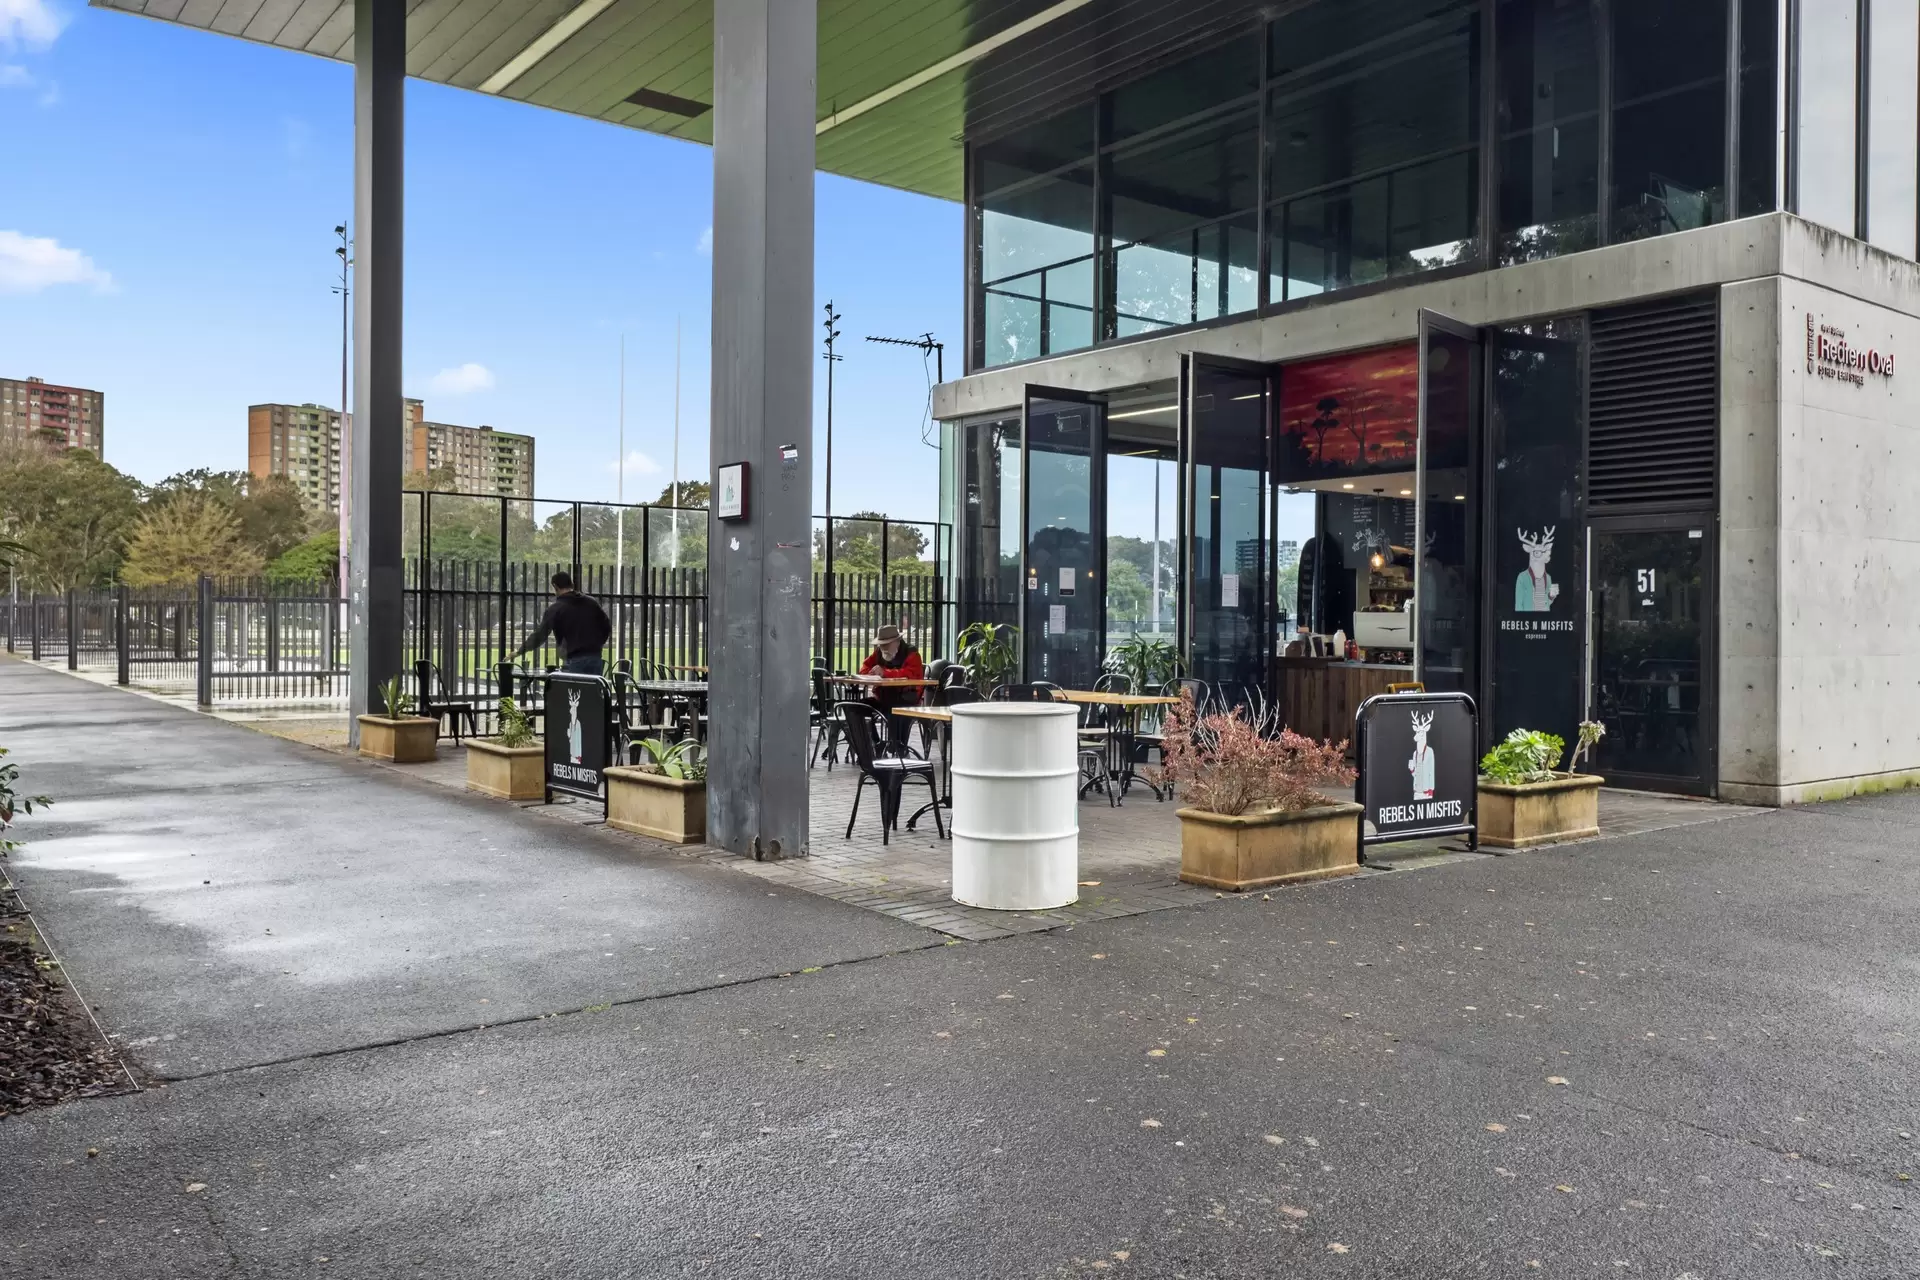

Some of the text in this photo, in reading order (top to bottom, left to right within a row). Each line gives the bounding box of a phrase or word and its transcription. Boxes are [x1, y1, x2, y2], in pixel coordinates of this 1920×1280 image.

[1818, 334, 1866, 372] Redfern
[1867, 348, 1895, 378] Oval
[1637, 568, 1656, 593] 51
[1501, 620, 1574, 632] REBELS N MISFITS
[553, 762, 598, 785] REBELS N MISFITS
[1379, 799, 1462, 825] REBELS N MISFITS
